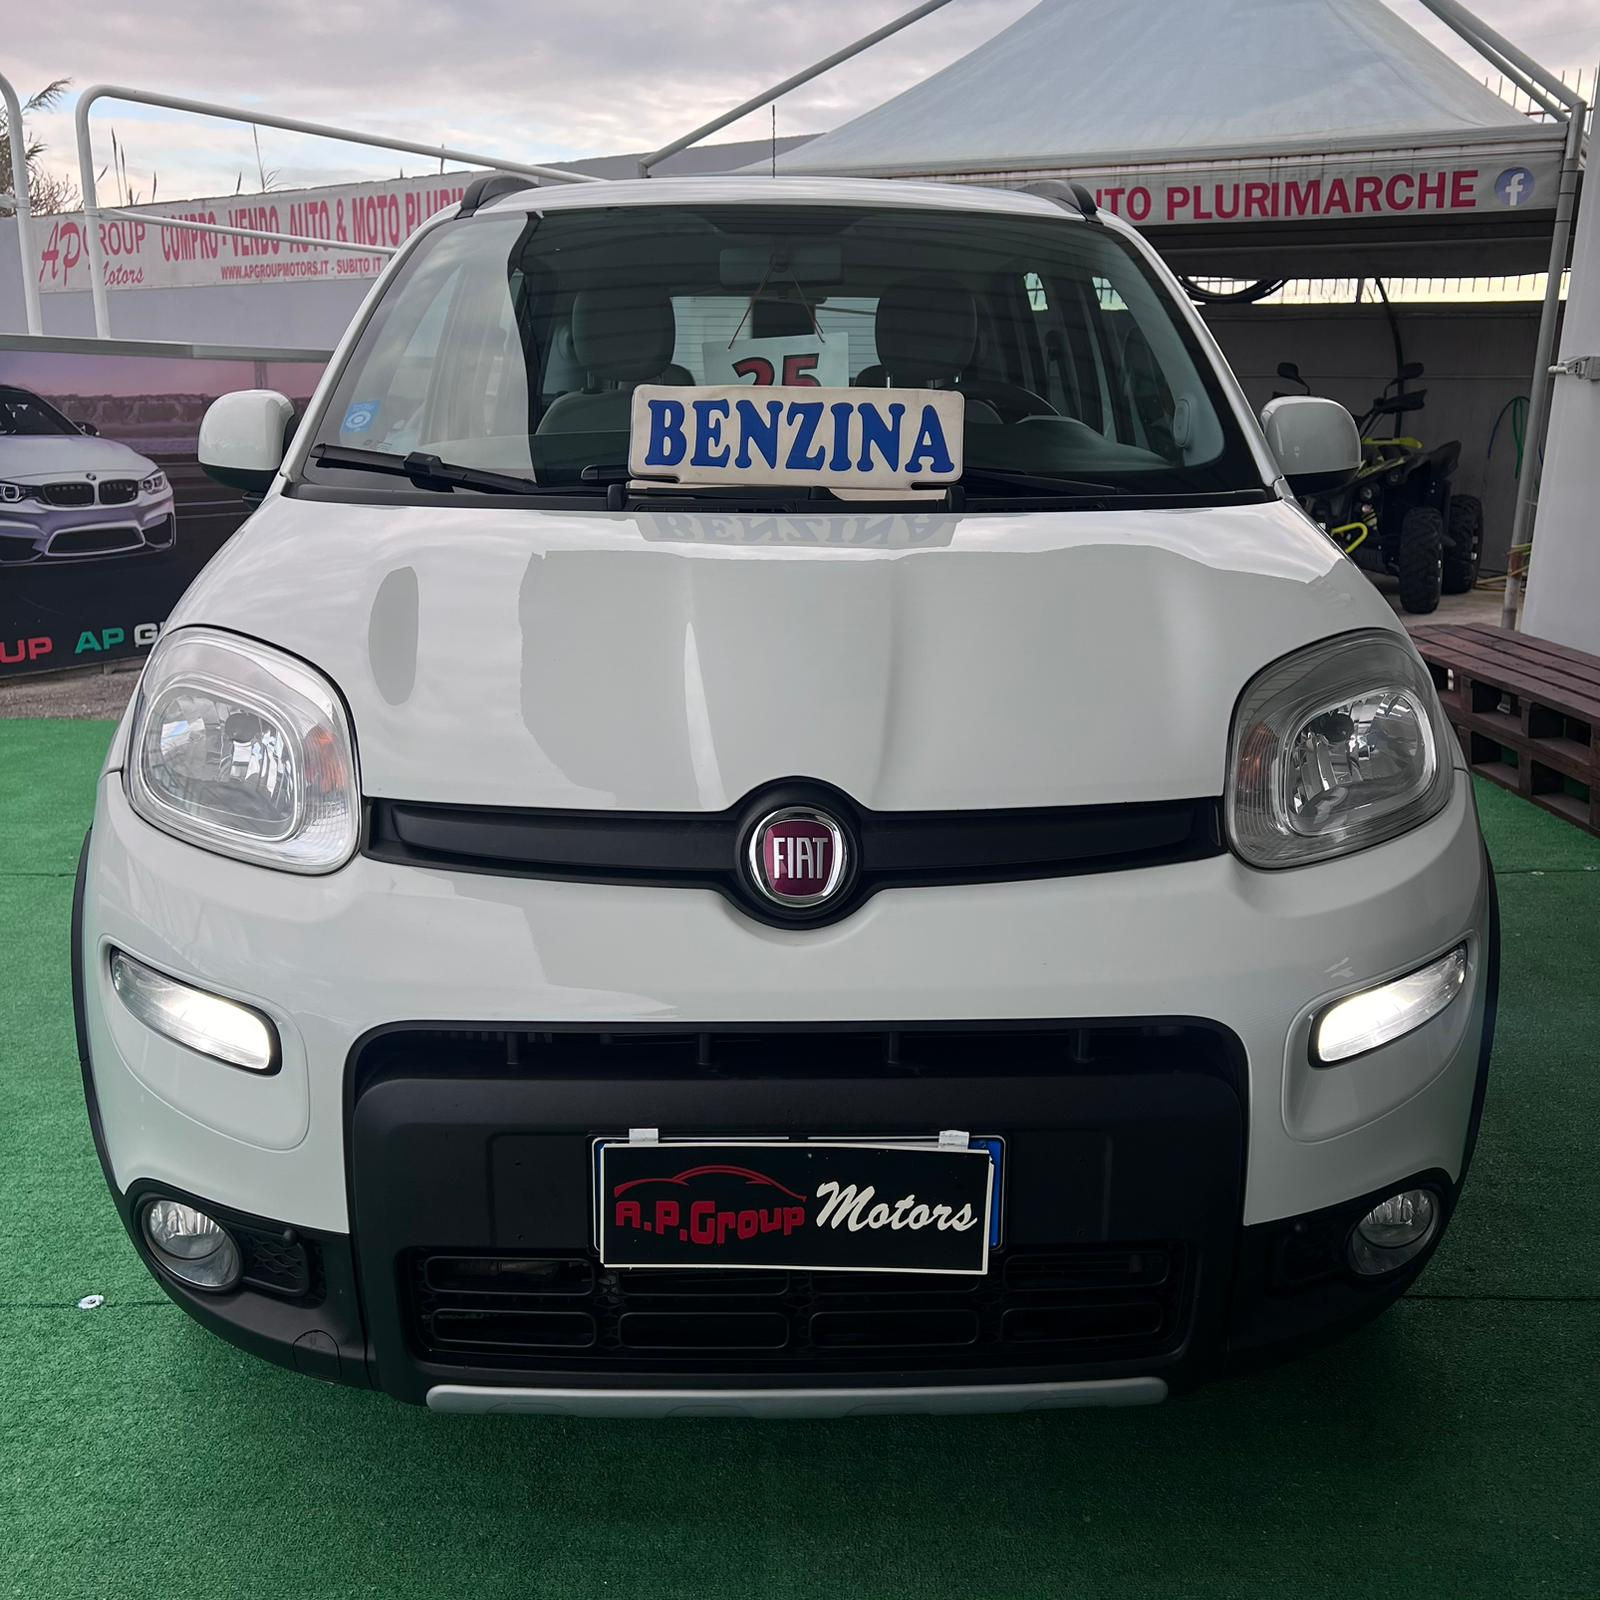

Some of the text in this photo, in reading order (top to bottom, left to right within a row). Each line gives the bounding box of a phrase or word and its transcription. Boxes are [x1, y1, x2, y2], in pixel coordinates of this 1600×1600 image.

[1166, 169, 1479, 221] PLURIMARCHE
[83, 220, 145, 256] ROUP
[228, 205, 280, 257] VENDO
[289, 201, 331, 254] AUTO
[352, 193, 400, 247] MOTO
[88, 260, 144, 286] otors
[221, 260, 329, 280] WWW.APGROUPMOTORS.IT
[337, 257, 370, 274] SUBITO
[373, 256, 382, 269] IT
[645, 399, 955, 473] BENZINA
[75, 627, 125, 654] AP
[134, 621, 167, 648] G
[773, 837, 829, 880] FIAT
[816, 1181, 978, 1232] Motors
